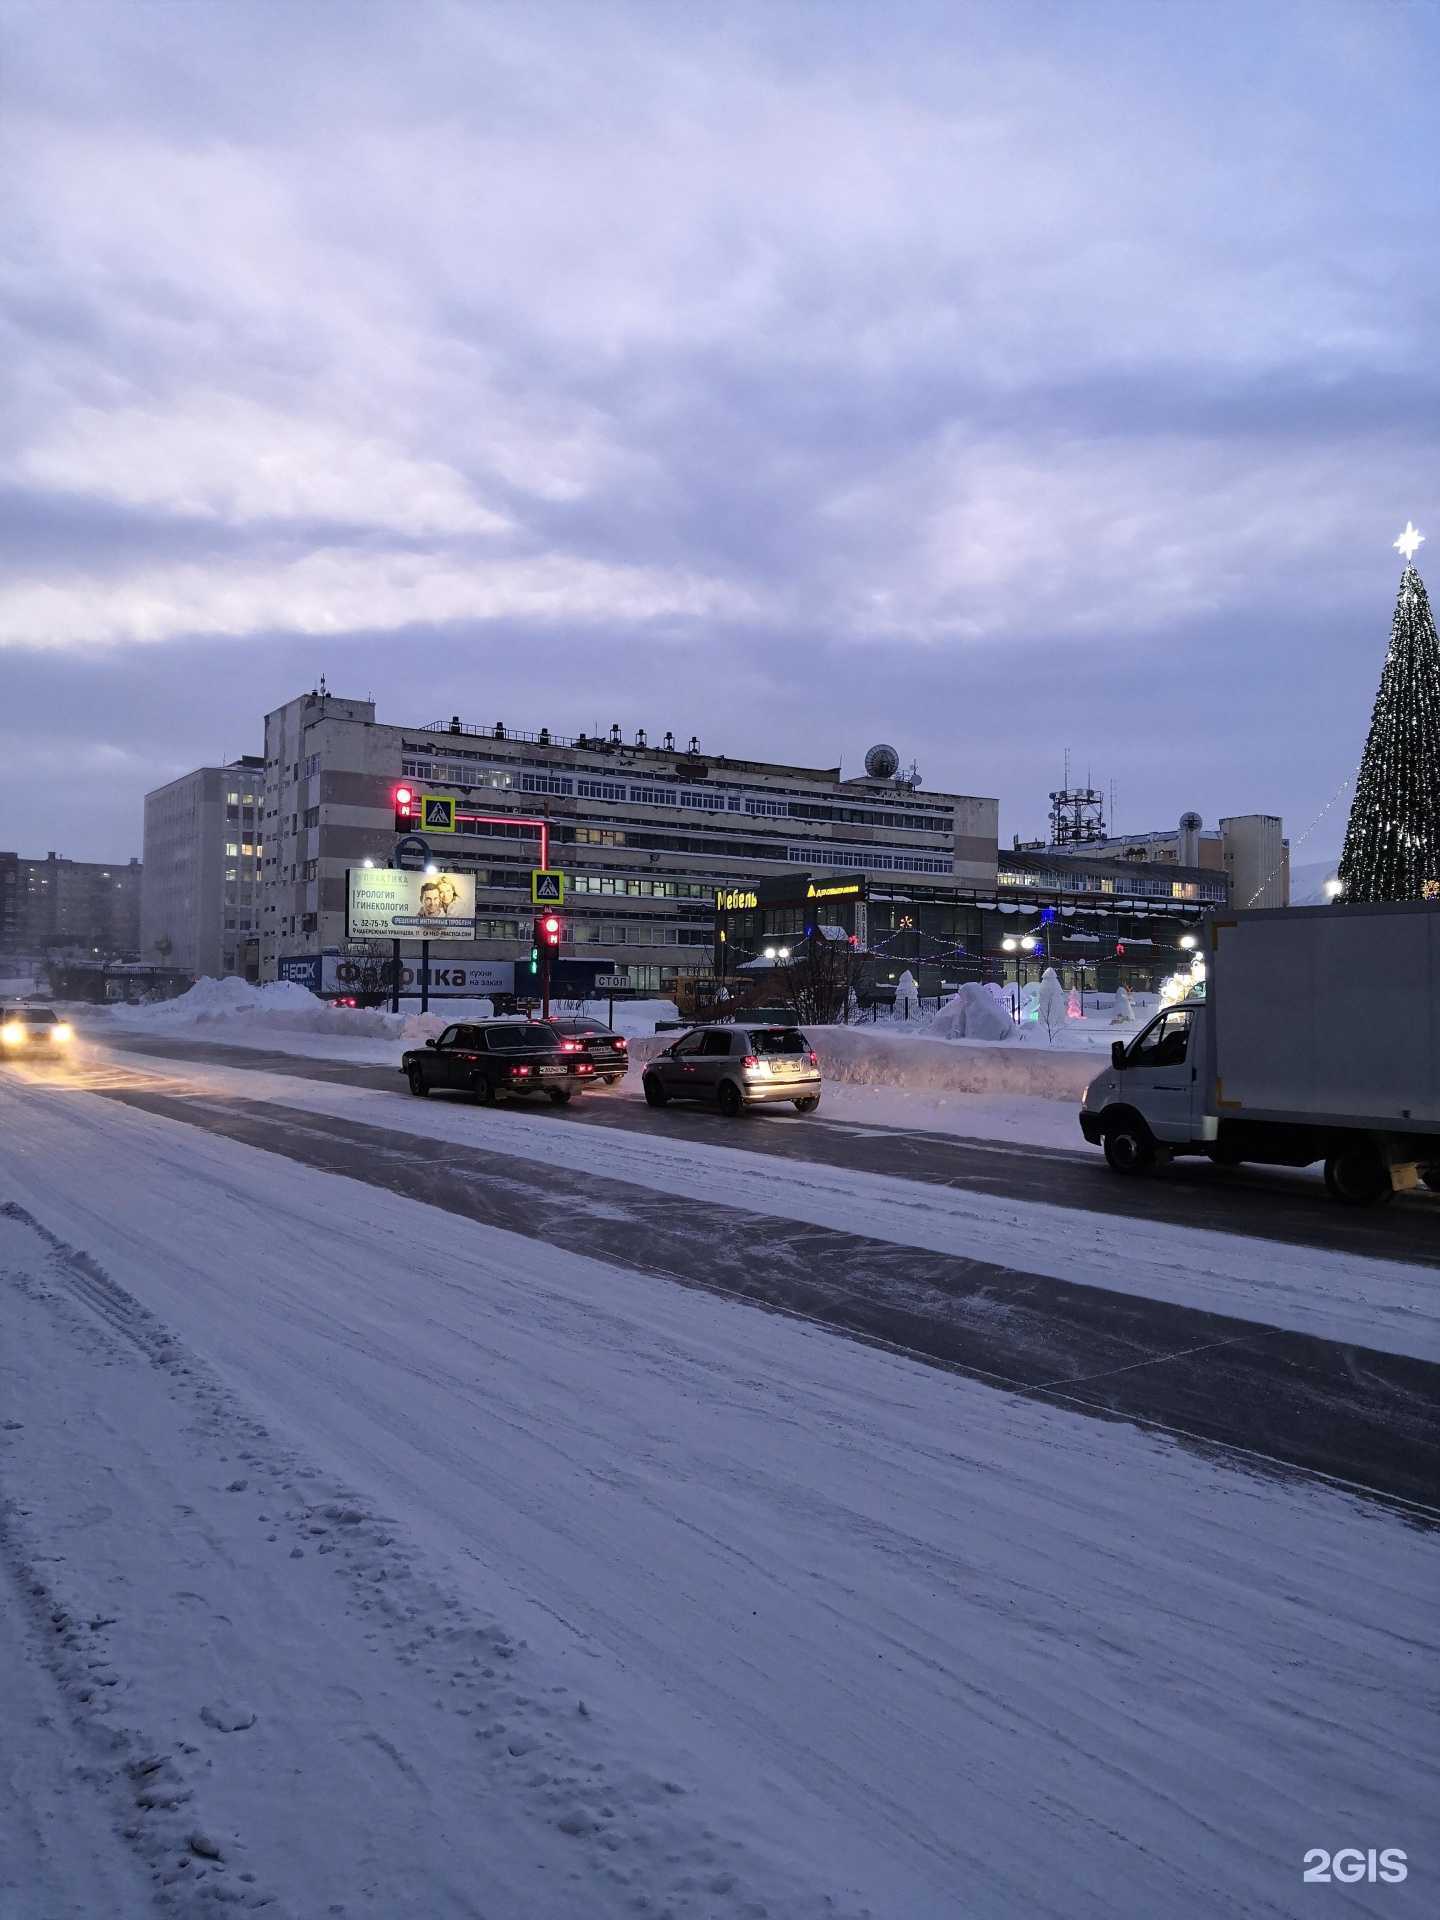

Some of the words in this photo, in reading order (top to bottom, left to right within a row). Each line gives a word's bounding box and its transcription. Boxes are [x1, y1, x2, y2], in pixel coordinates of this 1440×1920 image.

[356, 889, 395, 899] УРОЛОГИЯ
[717, 888, 758, 911] Мебель
[356, 901, 409, 912] ГИНЕКОЛОГИЯ
[360, 919, 389, 928] 32-75-75
[598, 976, 627, 986] СТОП
